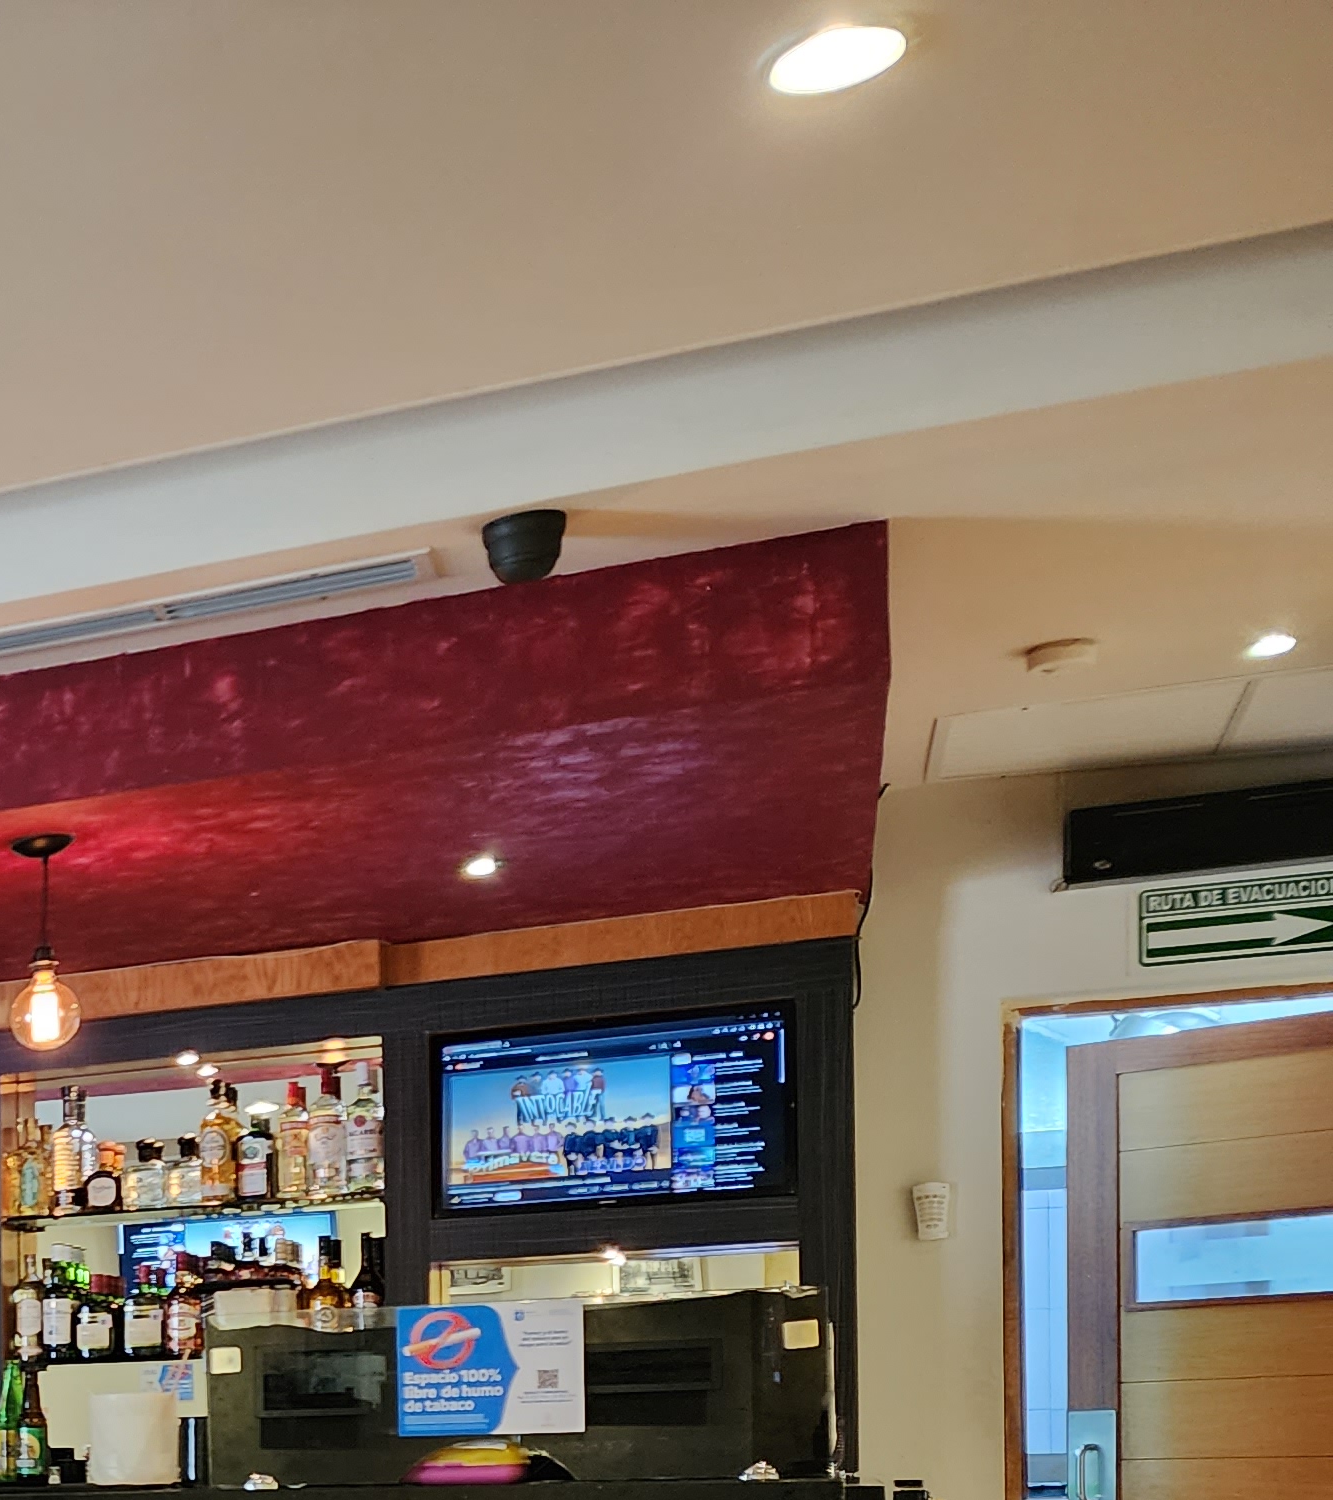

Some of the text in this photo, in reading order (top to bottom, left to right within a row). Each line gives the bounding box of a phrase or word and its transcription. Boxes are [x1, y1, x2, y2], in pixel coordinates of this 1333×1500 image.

[1148, 879, 1333, 911] RUTA DE EVACUACIO
[517, 1086, 602, 1121] INTOCABLE
[403, 1368, 502, 1386] Espacio 100%
[403, 1385, 437, 1399] libre
[440, 1385, 460, 1398] de
[462, 1384, 504, 1397] humo
[403, 1399, 475, 1413] de tabaco
